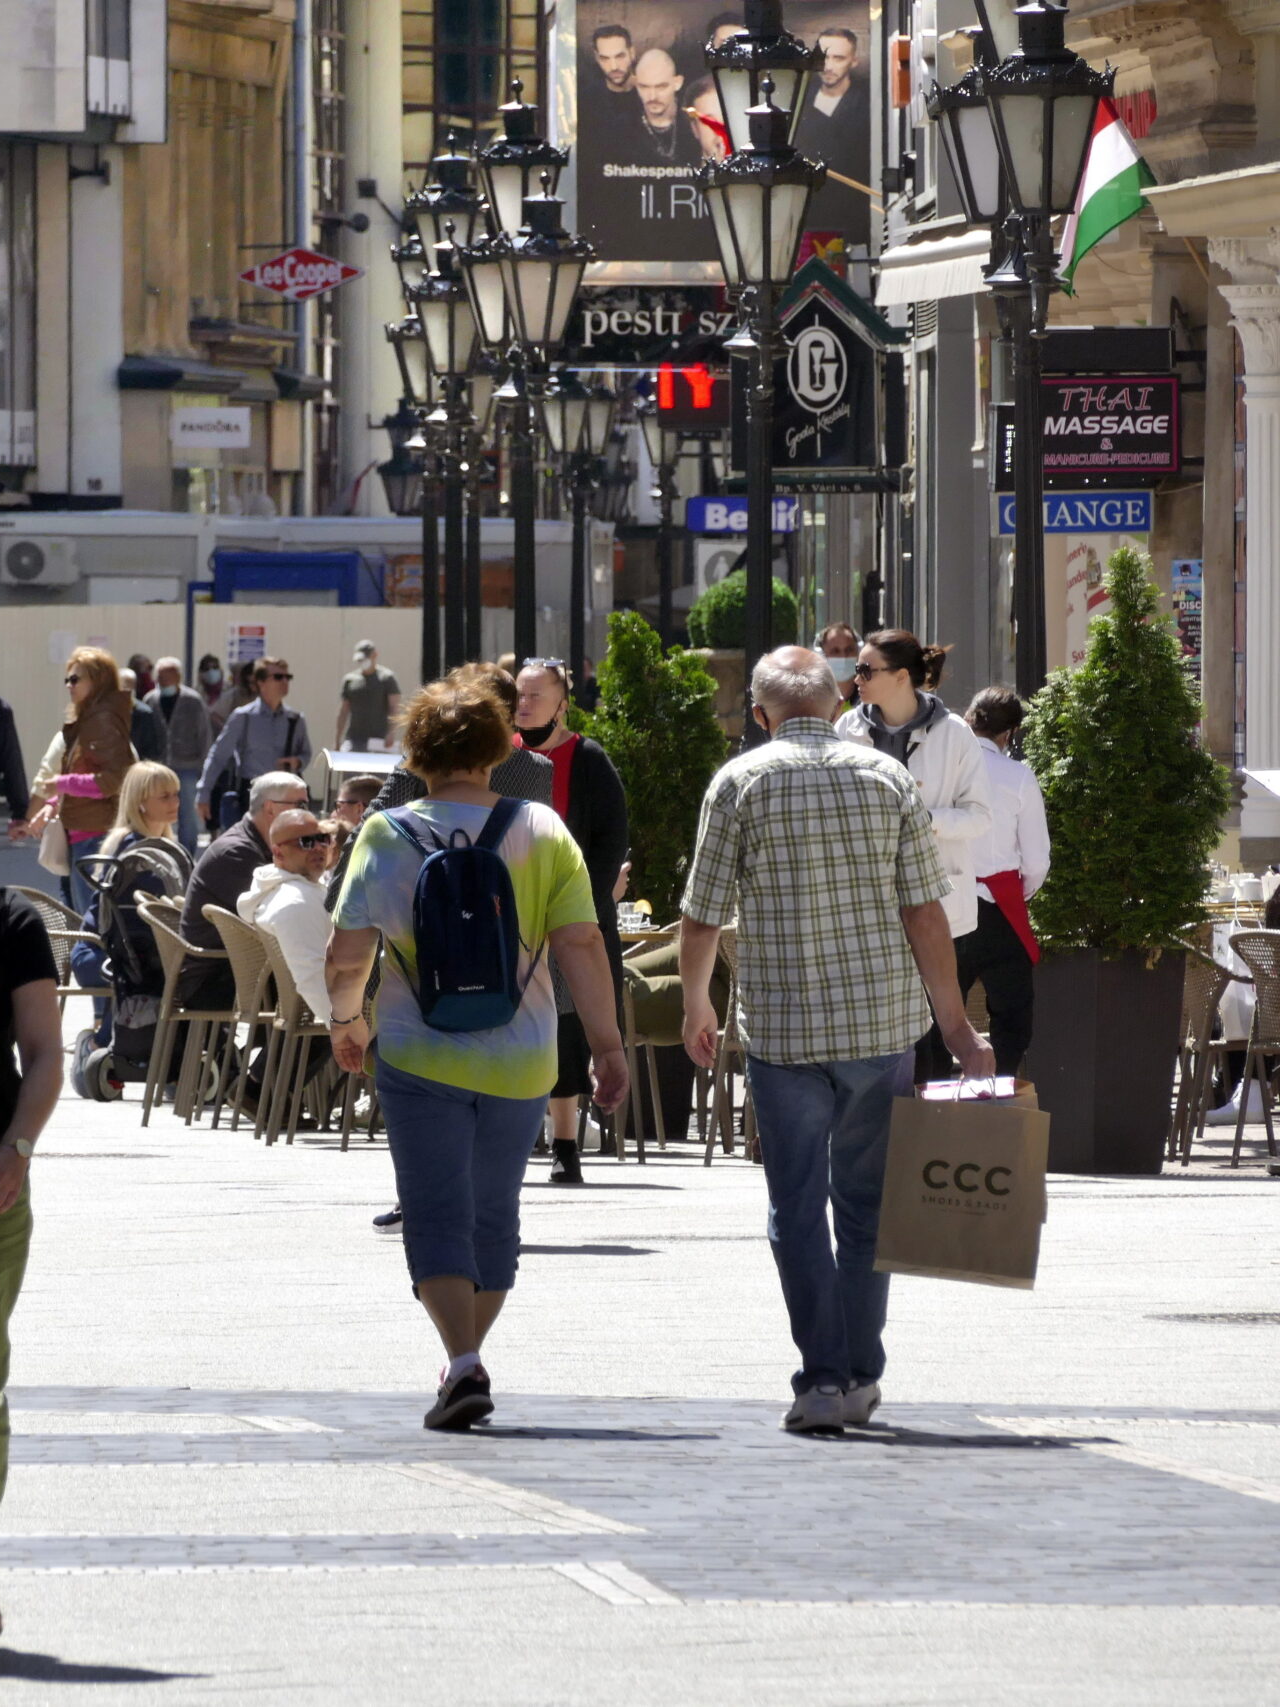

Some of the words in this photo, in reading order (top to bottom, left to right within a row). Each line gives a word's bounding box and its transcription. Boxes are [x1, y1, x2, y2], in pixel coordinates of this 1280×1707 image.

[604, 164, 702, 179] Shakespear
[255, 266, 282, 287] Lee
[284, 257, 340, 292] Cooper
[699, 311, 737, 336] sz
[1058, 386, 1154, 413] THAI
[180, 419, 241, 434] PANDORA
[1043, 415, 1170, 436] MASSAGE
[1100, 438, 1113, 451] &
[1043, 453, 1170, 466] MANICURE-PEDICURE
[1004, 501, 1146, 528] CANGE
[1179, 601, 1202, 610] DISC
[923, 1160, 1012, 1196] CCC
[921, 1195, 961, 1207] SHOES
